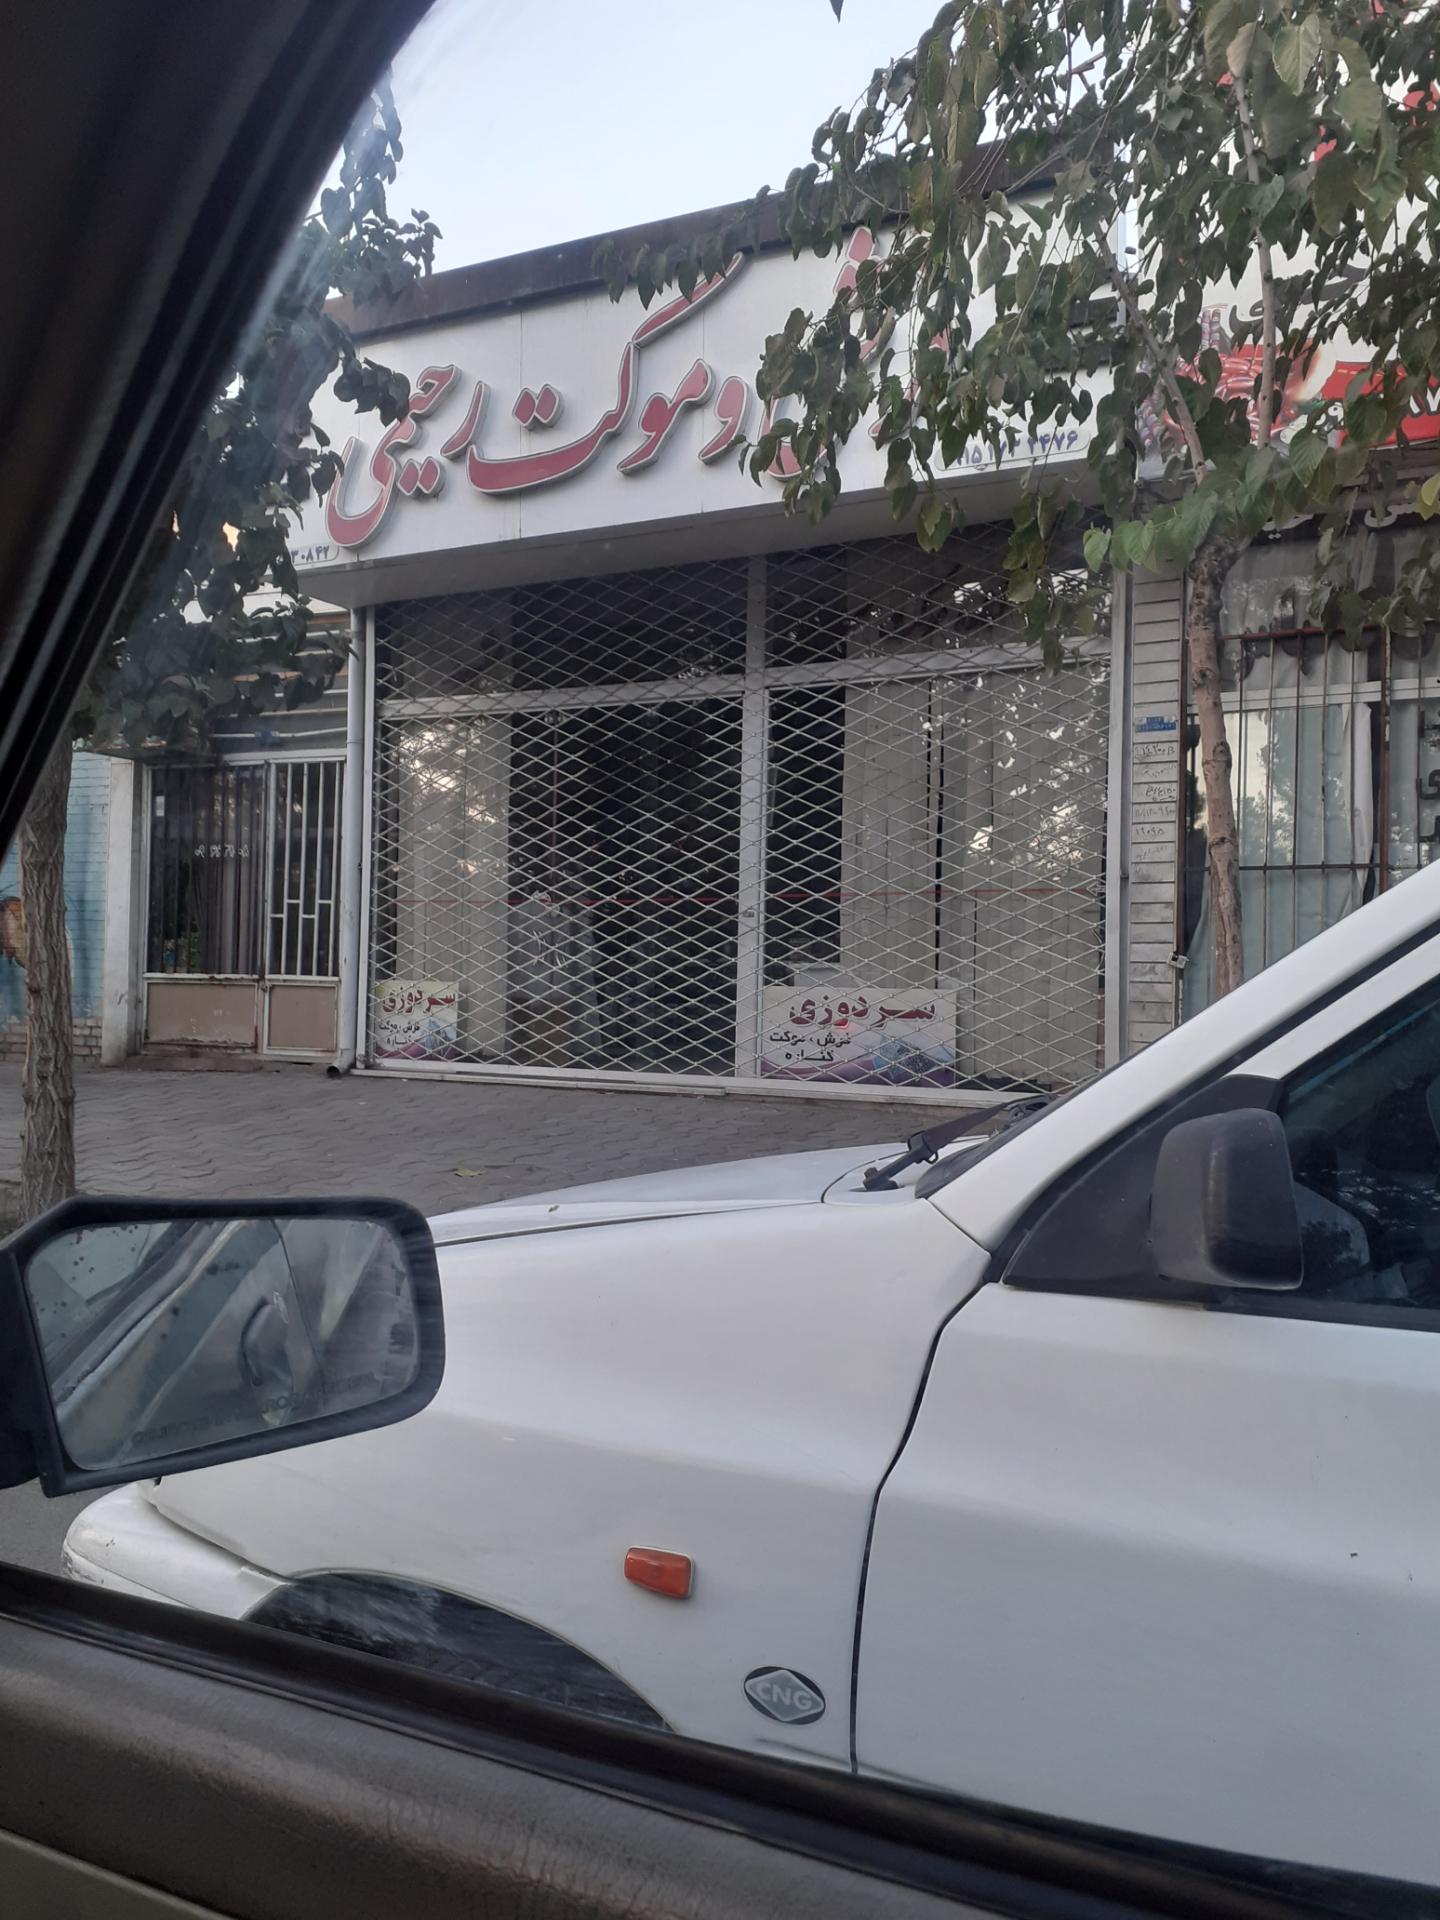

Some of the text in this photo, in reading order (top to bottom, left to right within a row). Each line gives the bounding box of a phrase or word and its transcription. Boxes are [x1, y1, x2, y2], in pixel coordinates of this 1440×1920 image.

[465, 250, 745, 496] موکت
[697, 376, 751, 464] و
[325, 363, 489, 549] رحیمی
[755, 1680, 812, 1710] CNG
